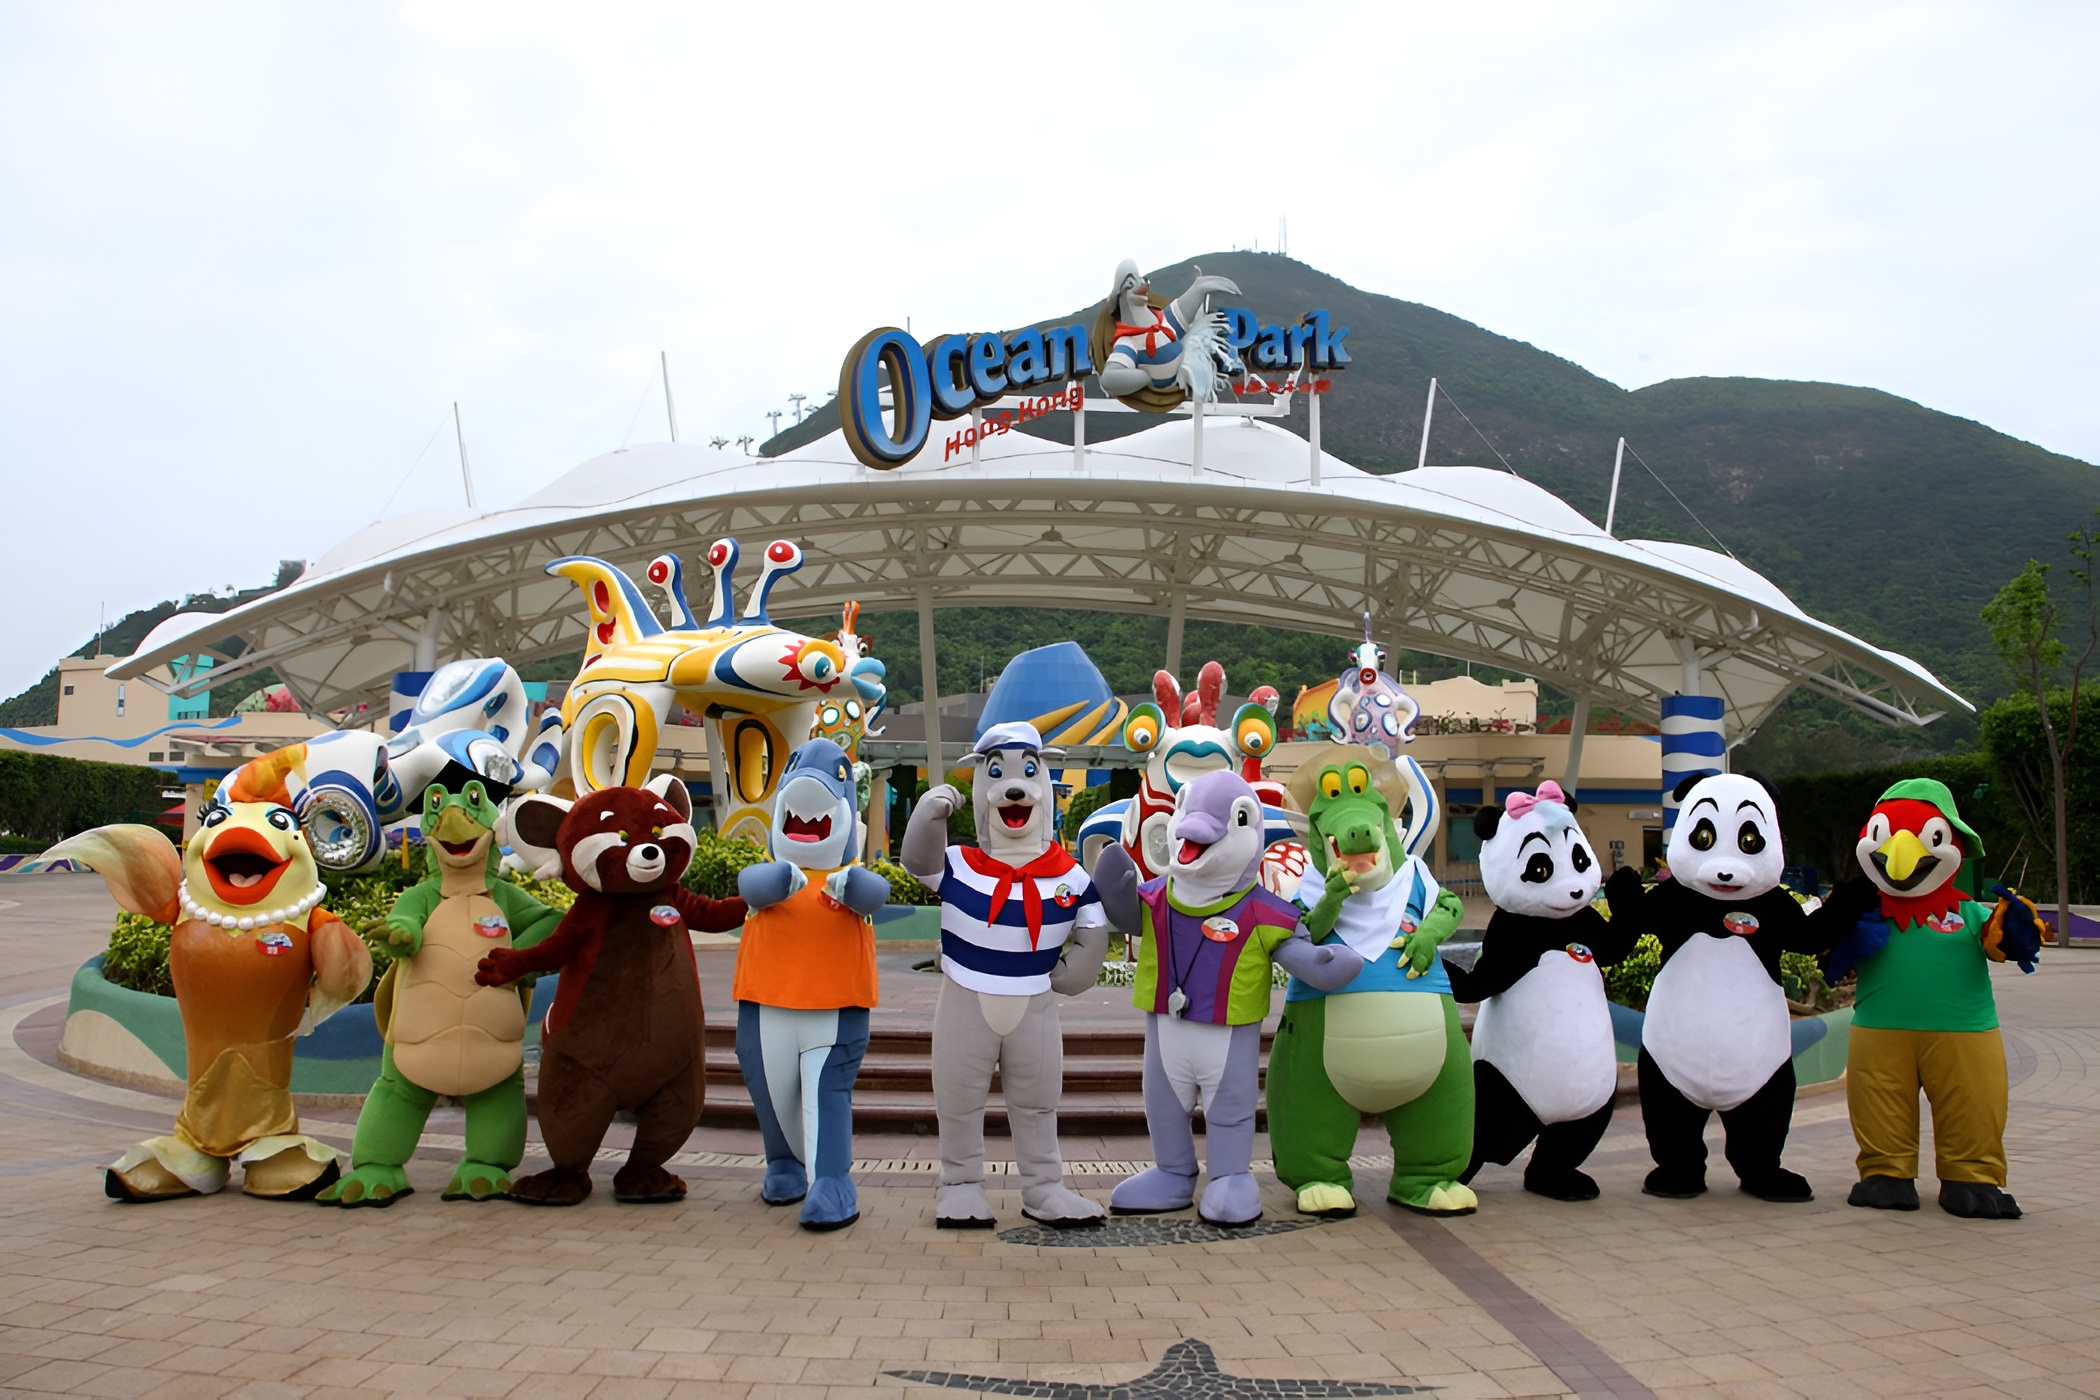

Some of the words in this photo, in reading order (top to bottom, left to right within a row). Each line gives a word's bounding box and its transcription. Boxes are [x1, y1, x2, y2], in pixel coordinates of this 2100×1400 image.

[846, 323, 1093, 464] Ocean
[1218, 307, 1352, 367] Park
[944, 410, 1013, 462] Hong
